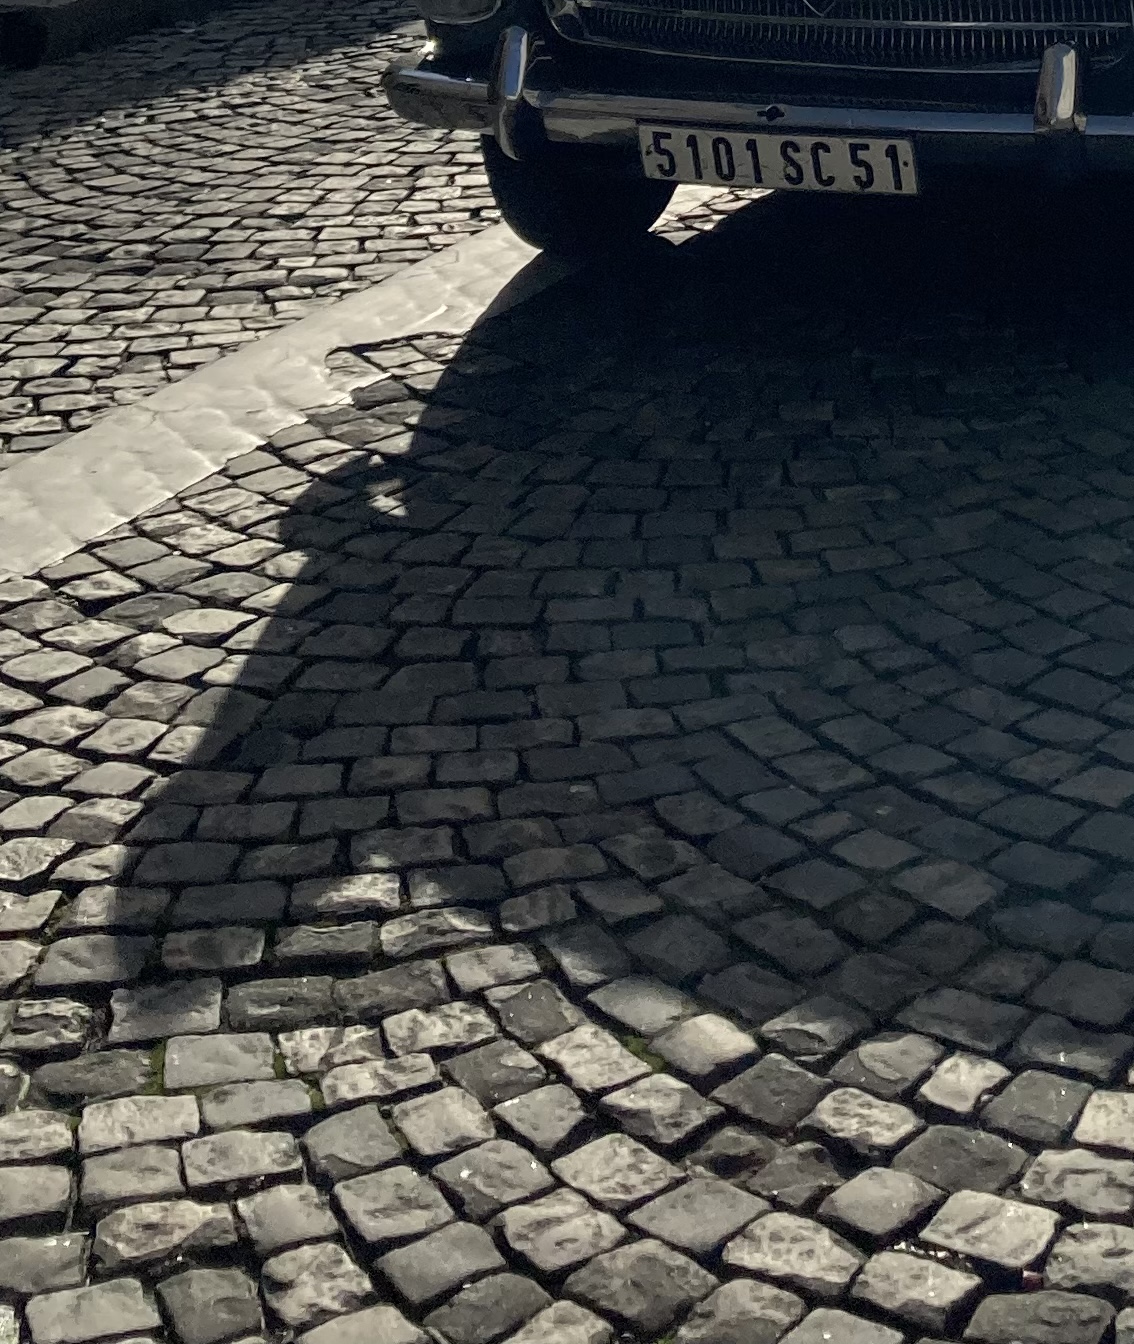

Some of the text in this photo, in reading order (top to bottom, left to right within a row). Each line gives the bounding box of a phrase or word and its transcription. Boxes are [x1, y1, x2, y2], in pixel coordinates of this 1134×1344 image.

[651, 131, 904, 191] 5101 SC 51
